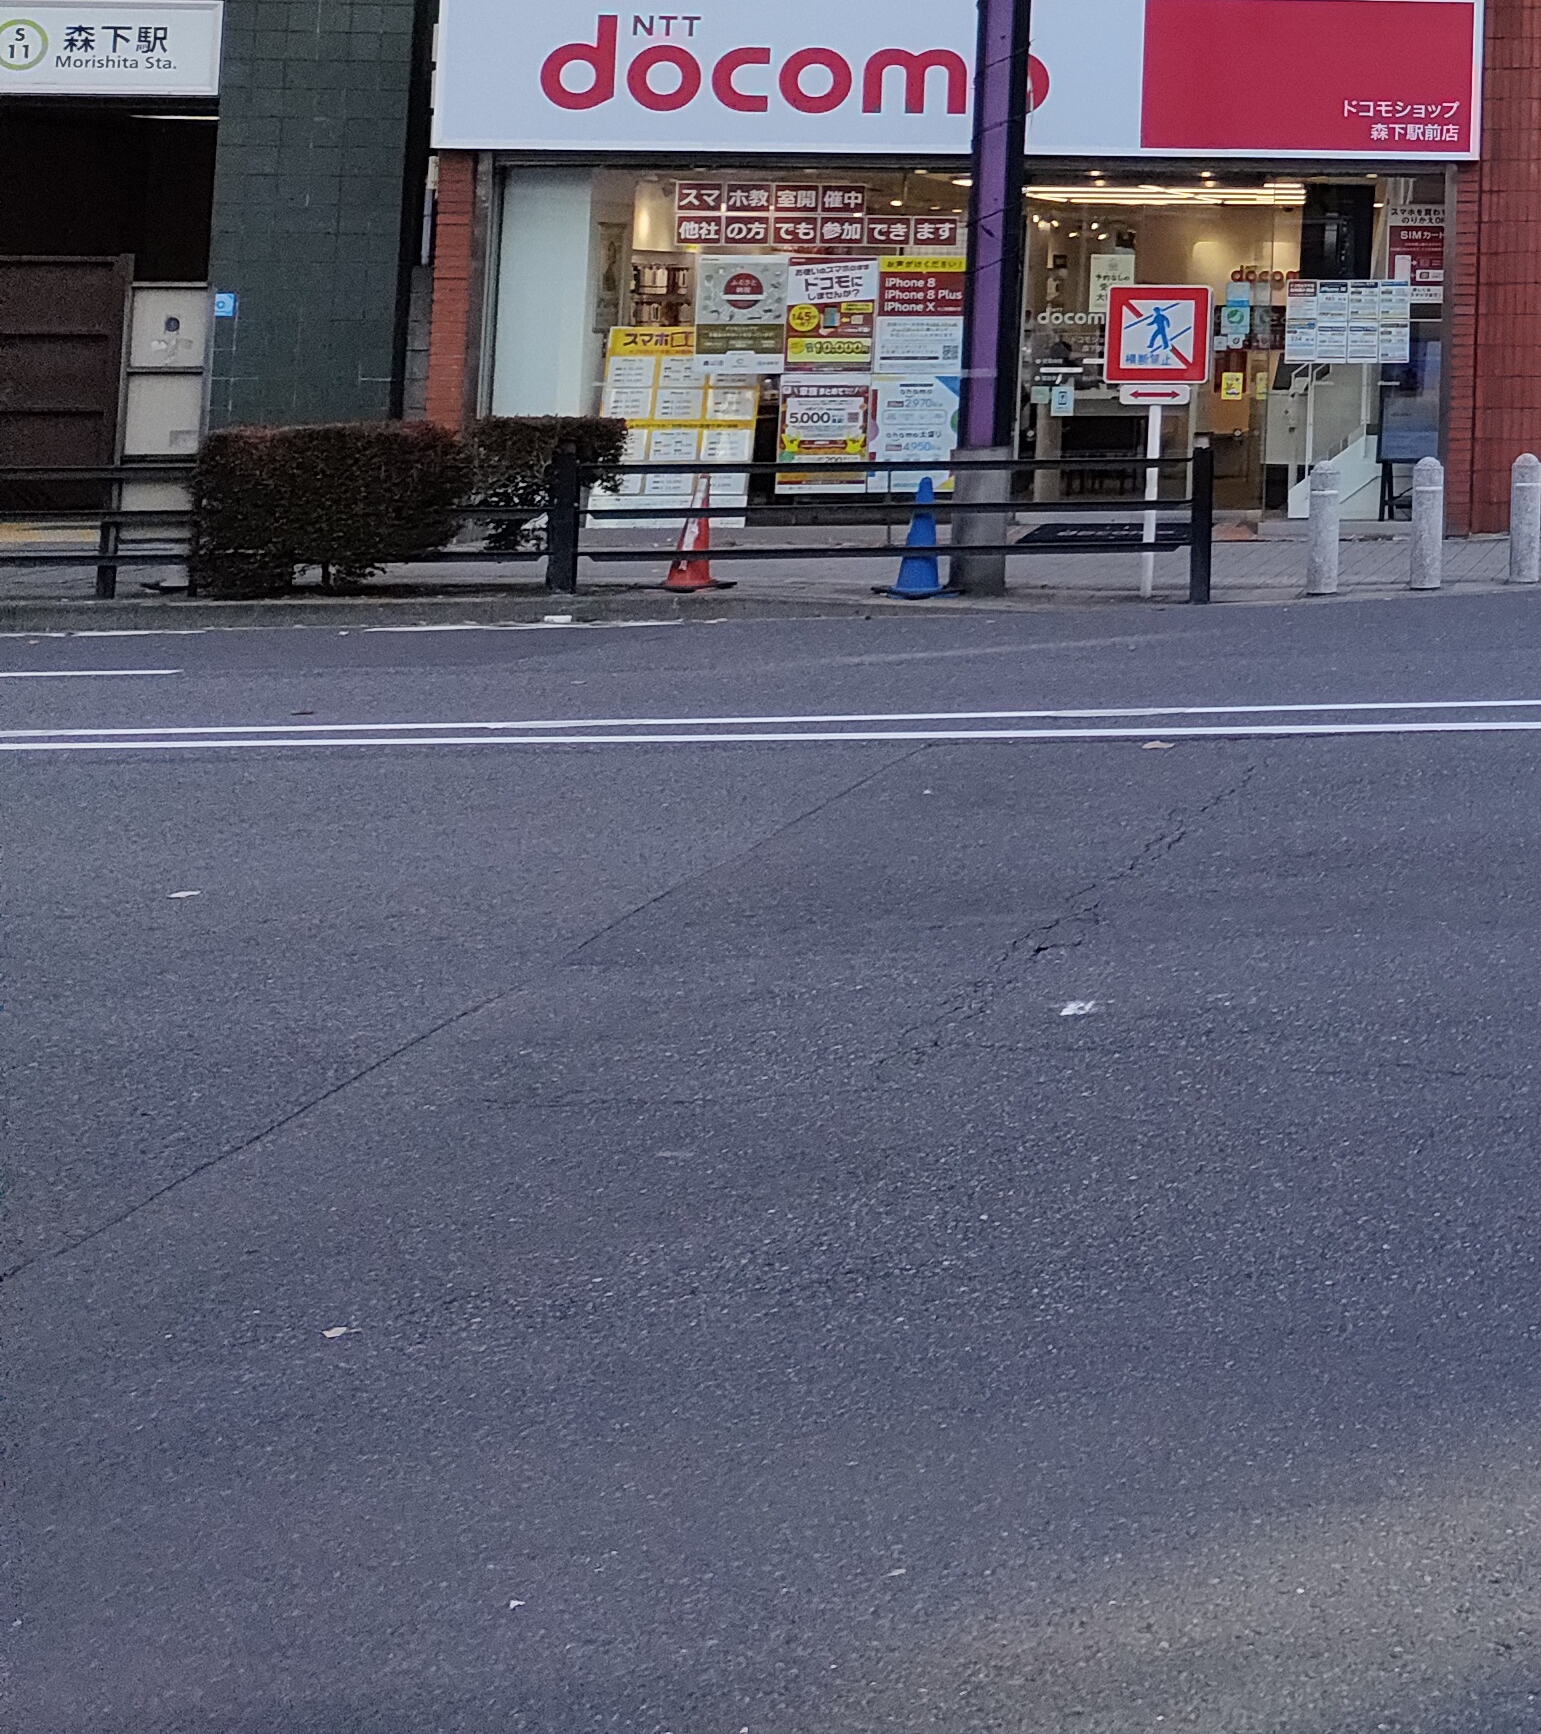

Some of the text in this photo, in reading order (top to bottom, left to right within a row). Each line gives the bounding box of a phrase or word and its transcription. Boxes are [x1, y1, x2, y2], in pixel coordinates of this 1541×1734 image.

[15, 27, 26, 42] S
[632, 15, 702, 38] NTT
[63, 24, 169, 54] 森下駅
[8, 44, 30, 59] 11
[55, 55, 177, 70] Morishita Sta.
[1343, 99, 1460, 118] ドコモショップ
[1370, 123, 1460, 141] 森下駅前店
[679, 189, 864, 209] スマホ教室開催中
[678, 221, 956, 240] 他社の方でも参加できます
[804, 274, 864, 292] ドコモに
[885, 277, 936, 288] iPhone 8
[884, 289, 963, 300] iPhone 8 Plus
[884, 301, 925, 312] iPhone
[926, 301, 936, 312] X
[1125, 353, 1172, 366] 横断禁止
